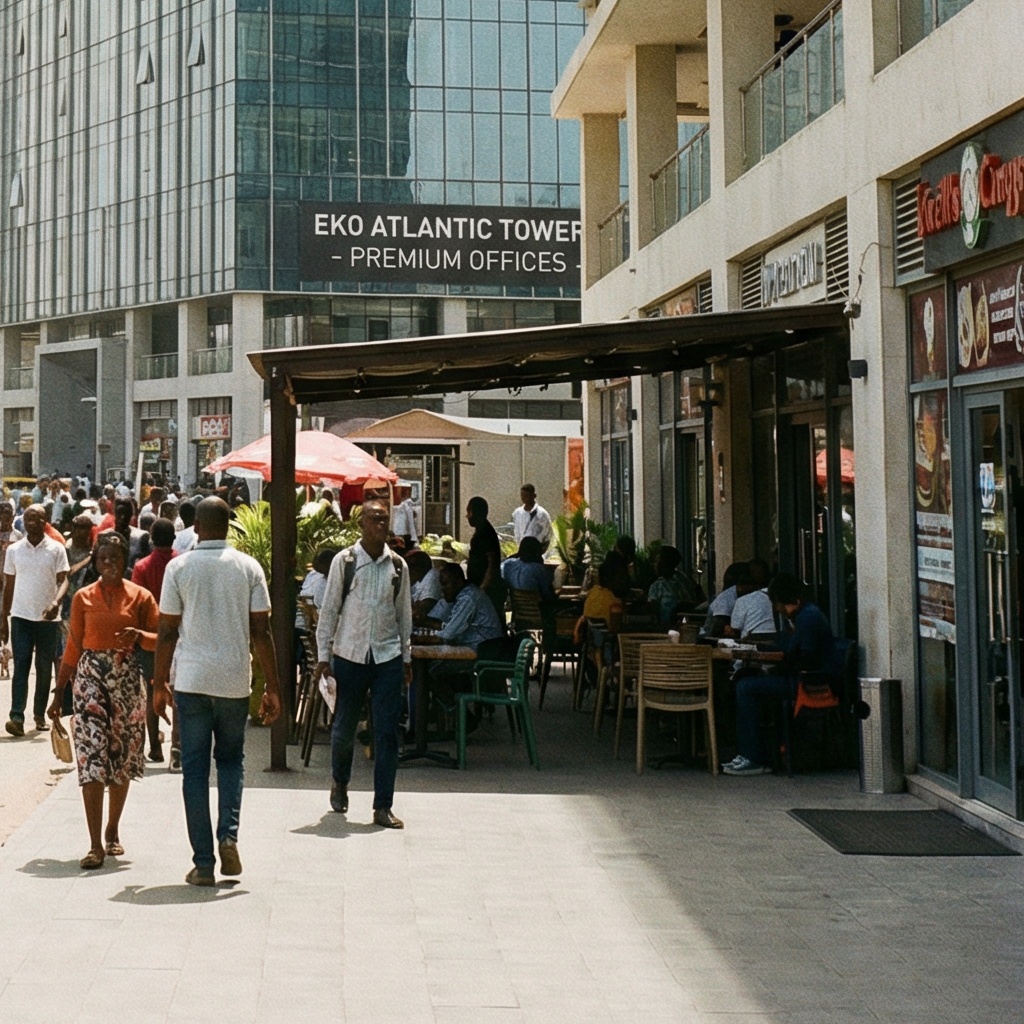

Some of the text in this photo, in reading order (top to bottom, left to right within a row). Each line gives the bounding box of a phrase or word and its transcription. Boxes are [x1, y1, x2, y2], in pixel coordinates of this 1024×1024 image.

[314, 213, 364, 236] EKO
[370, 215, 493, 241] ATLANTIC
[350, 246, 462, 270] PREMIUM
[469, 249, 567, 273] OFFICES
